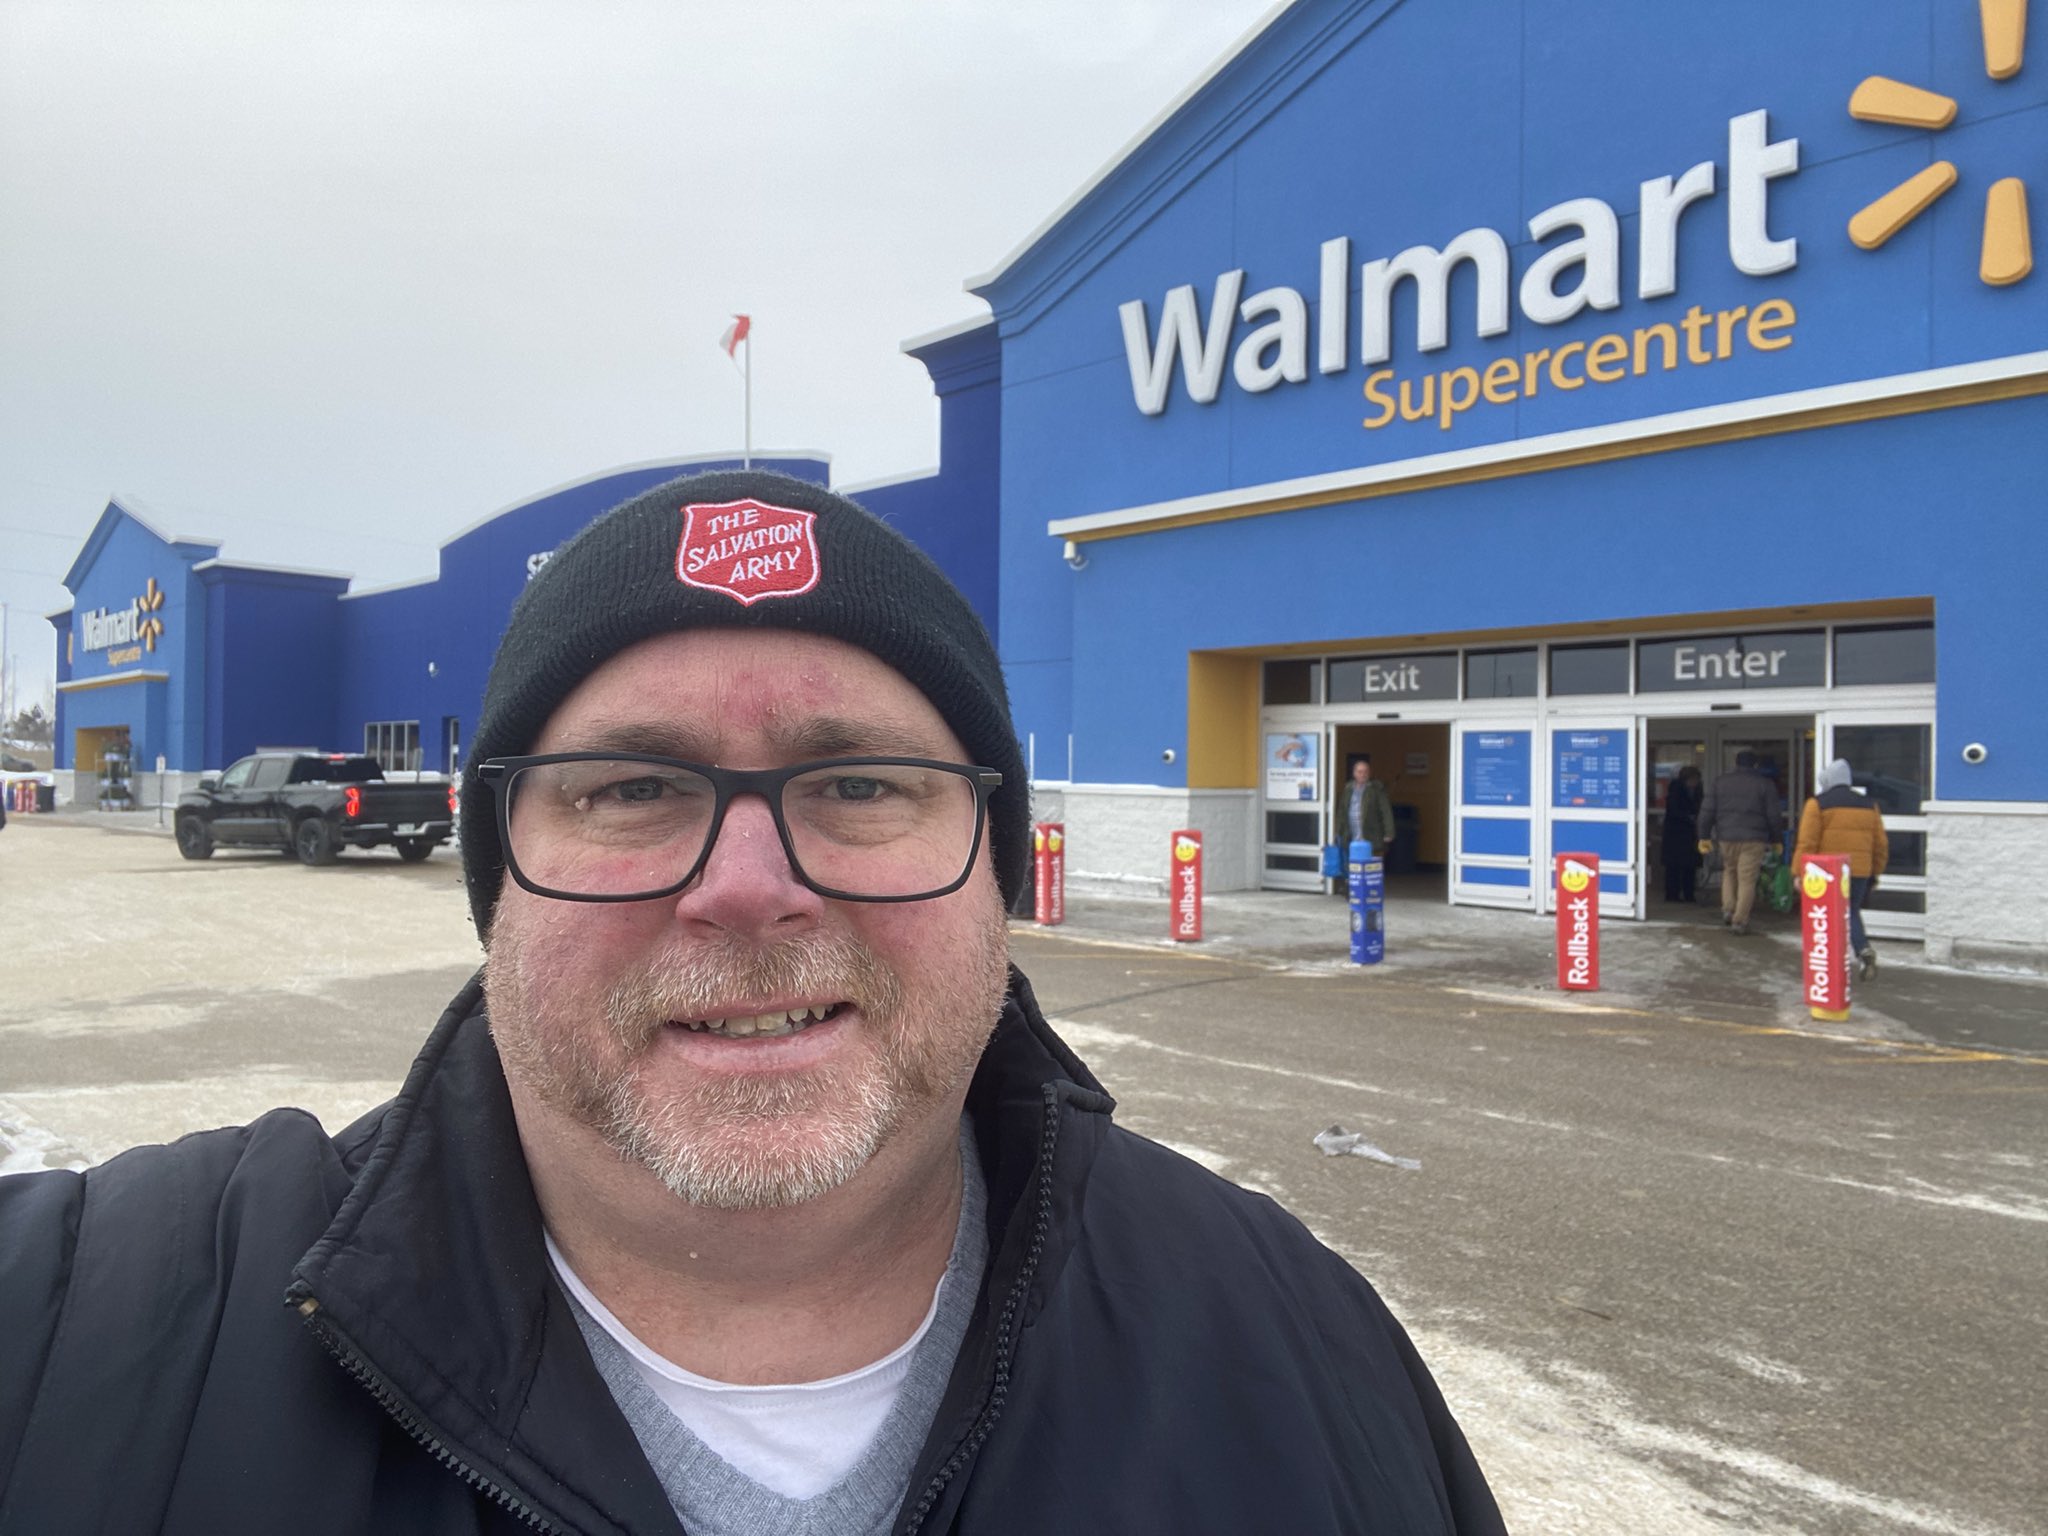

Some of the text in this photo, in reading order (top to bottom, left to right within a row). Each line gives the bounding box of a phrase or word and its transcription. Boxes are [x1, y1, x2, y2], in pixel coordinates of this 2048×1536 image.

[1118, 108, 1800, 417] Walmart
[1362, 297, 1798, 430] Supercentre
[686, 519, 803, 573] SALVATION
[707, 508, 760, 536] THE
[728, 545, 802, 584] ARMY
[81, 597, 140, 652] Walmart
[1363, 662, 1421, 694] Exit
[1673, 646, 1787, 681] Enter
[1050, 855, 1061, 919] Rollback
[1179, 865, 1196, 935] Rollback
[1567, 896, 1590, 985] Rollback
[1807, 904, 1830, 1003] Rollback
